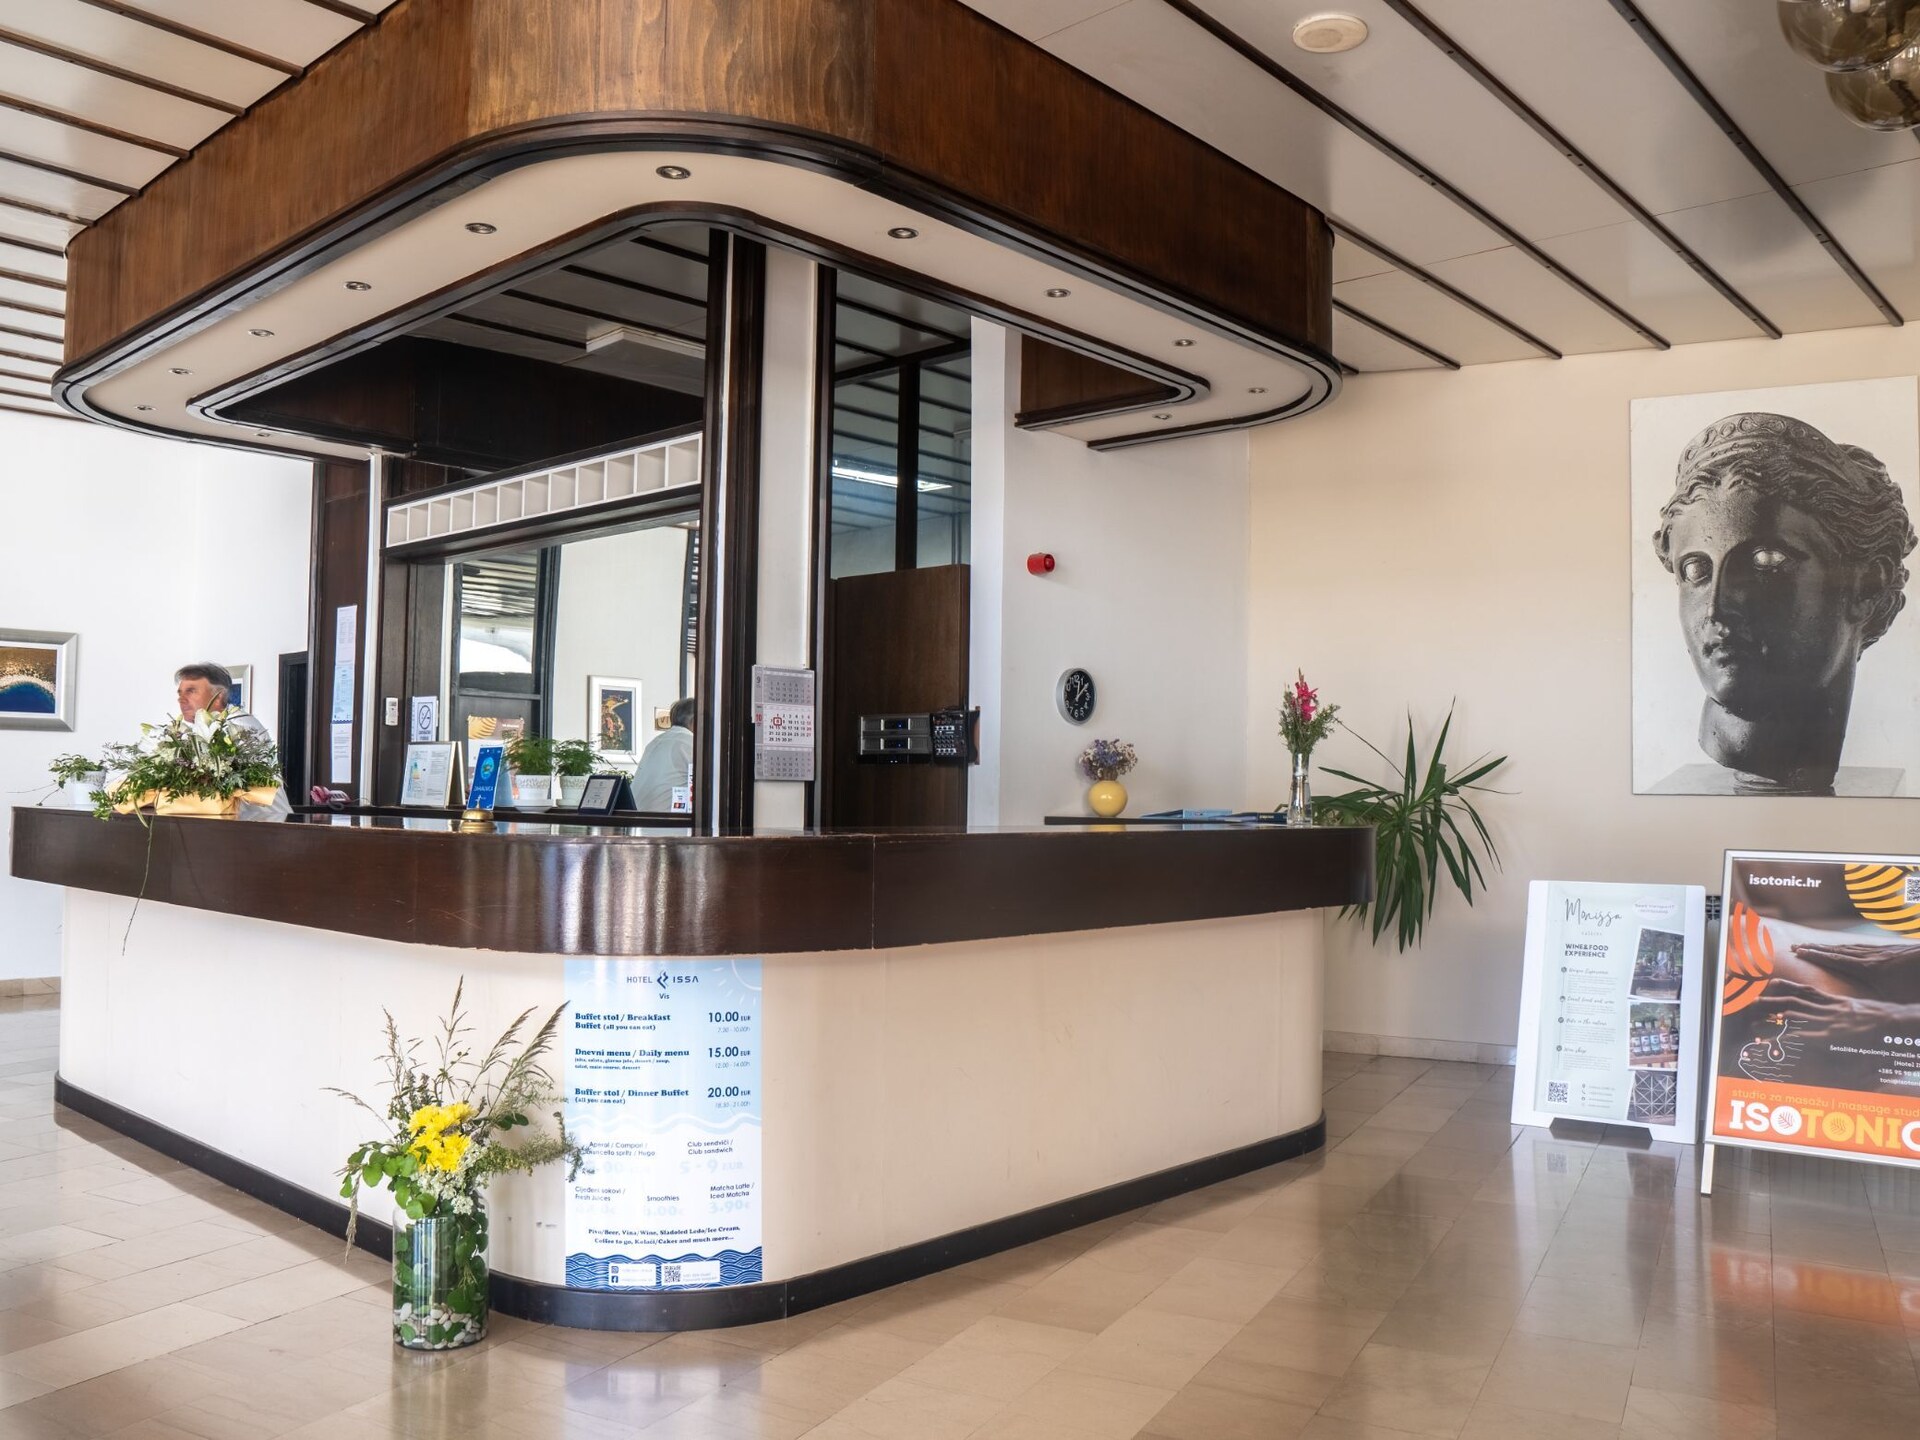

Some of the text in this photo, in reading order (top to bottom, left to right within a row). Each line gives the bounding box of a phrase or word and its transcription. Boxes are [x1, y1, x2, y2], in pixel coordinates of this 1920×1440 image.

[1749, 874, 1822, 888] isotonic.hr
[709, 1012, 739, 1022] 10.00
[709, 1046, 739, 1058] 15.00
[707, 1086, 739, 1098] 20.00
[1731, 1088, 1766, 1100] studio
[1784, 1095, 1828, 1107] masažu
[1838, 1102, 1891, 1115] massage
[707, 1159, 718, 1172] 9
